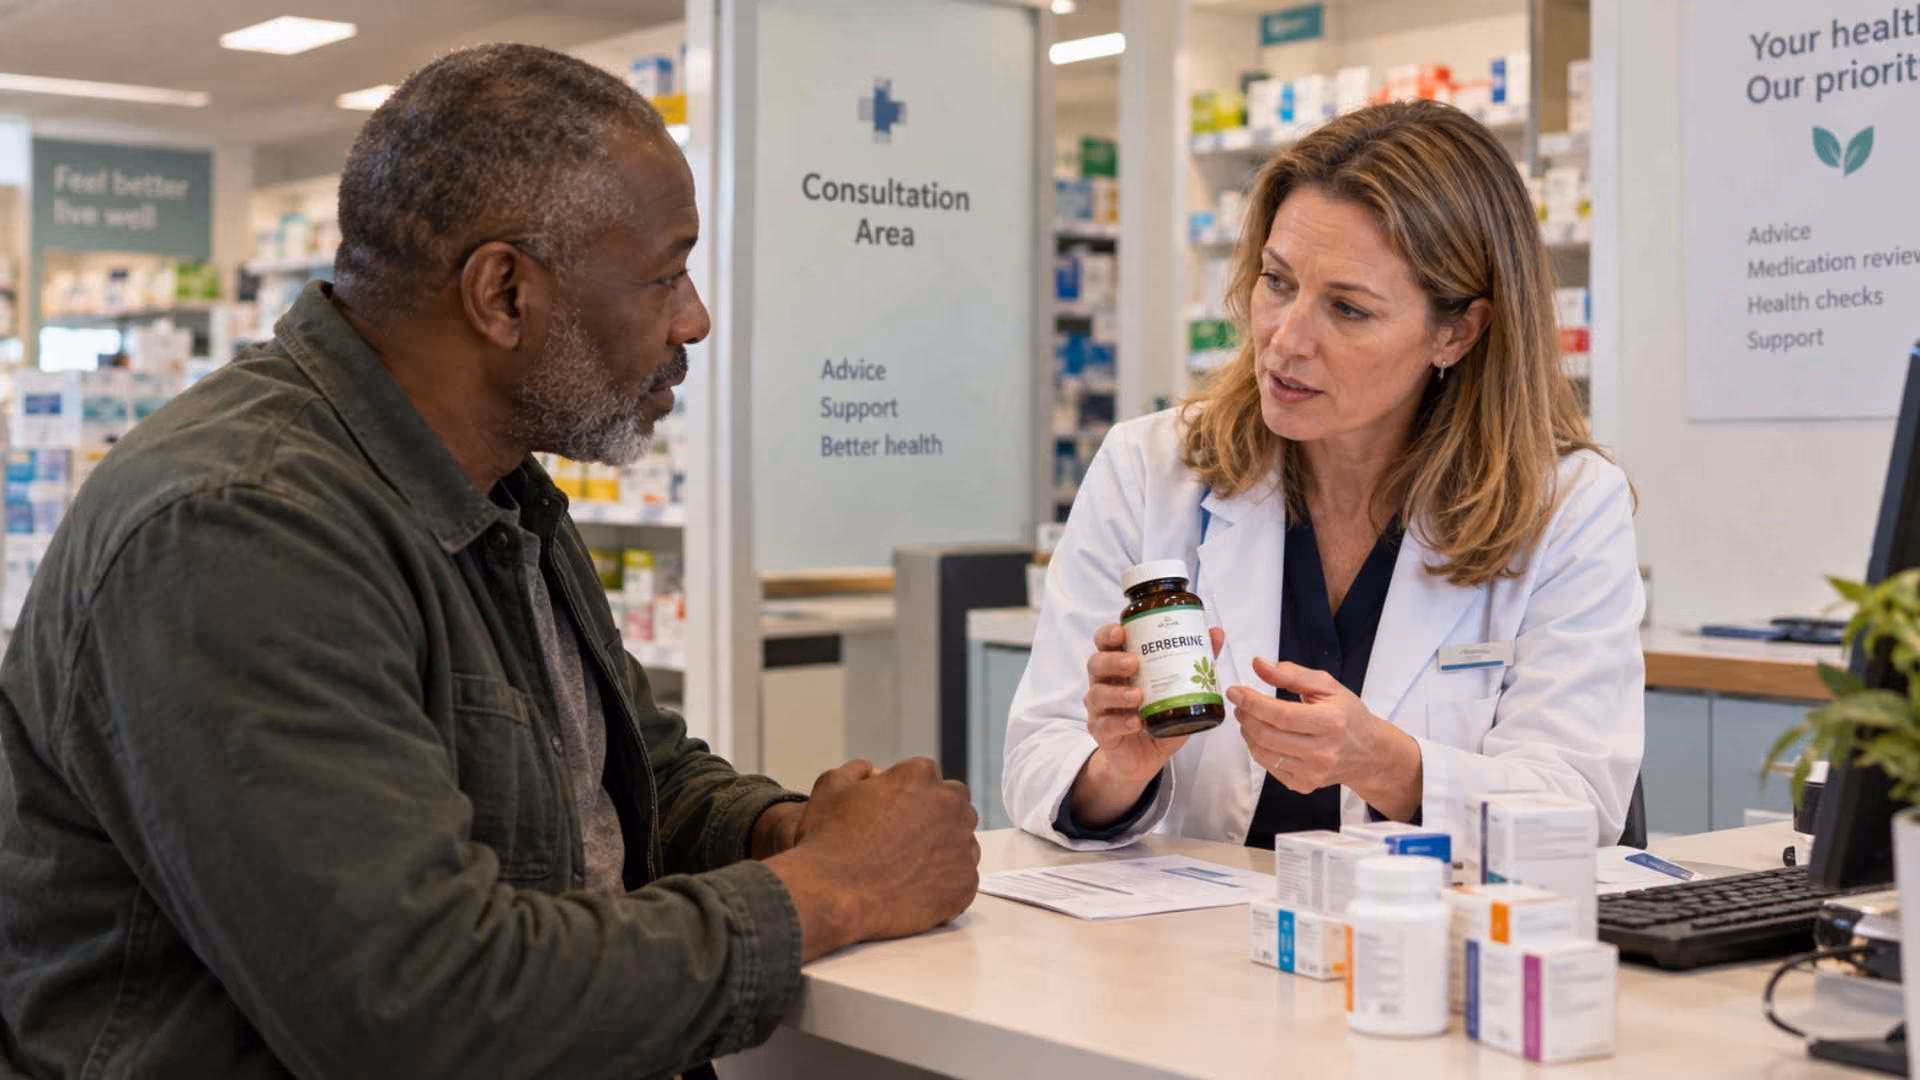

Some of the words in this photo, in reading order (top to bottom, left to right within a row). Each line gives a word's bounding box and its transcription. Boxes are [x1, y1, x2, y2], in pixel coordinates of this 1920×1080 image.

[1749, 30, 1822, 62] Your
[1831, 3, 1920, 50] healt
[1747, 74, 1806, 105] Our
[1815, 51, 1920, 103] priorit
[53, 164, 108, 194] Feel
[112, 169, 189, 200] better
[801, 172, 971, 212] Consultation
[854, 217, 915, 248] Area
[1747, 223, 1812, 246] Advice
[1747, 251, 1856, 279] Medication
[1747, 290, 1810, 315] Health
[1814, 285, 1884, 311] checks
[1747, 327, 1824, 353] Support
[821, 357, 887, 381] Advice
[820, 395, 899, 424] Support
[820, 434, 880, 458] Better
[884, 433, 943, 457] health
[1140, 634, 1204, 656] BERBERINE
